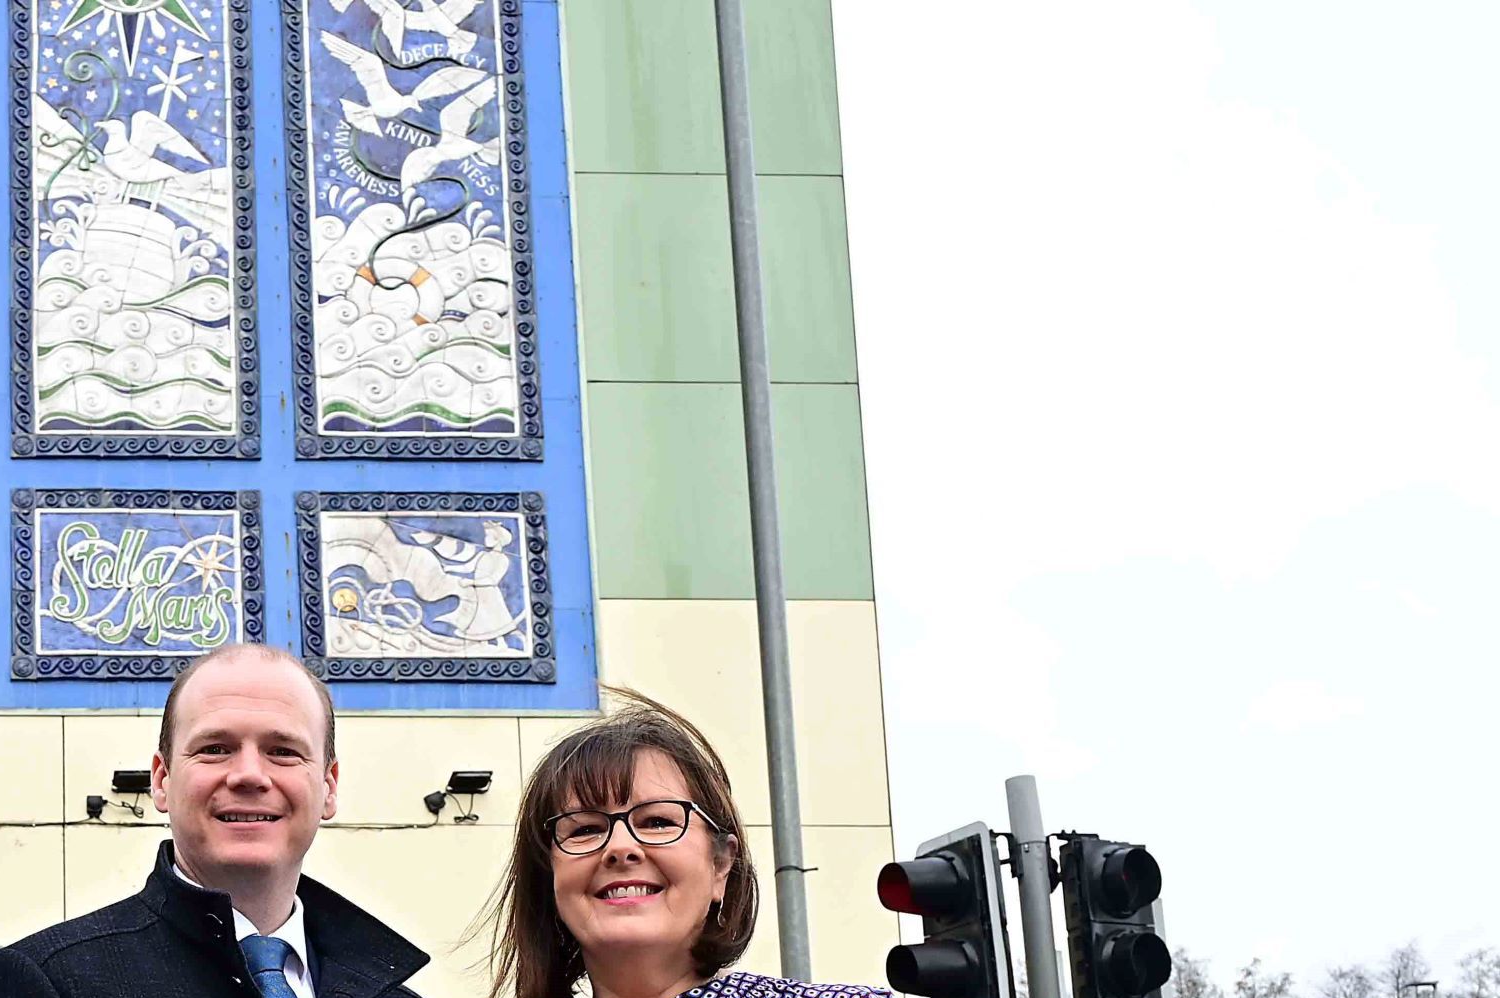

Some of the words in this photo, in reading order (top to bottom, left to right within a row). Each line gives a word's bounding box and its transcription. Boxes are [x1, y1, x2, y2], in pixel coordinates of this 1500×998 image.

[333, 119, 400, 197] AWARENESS
[51, 521, 167, 622] Stella
[97, 585, 235, 648] Maris
